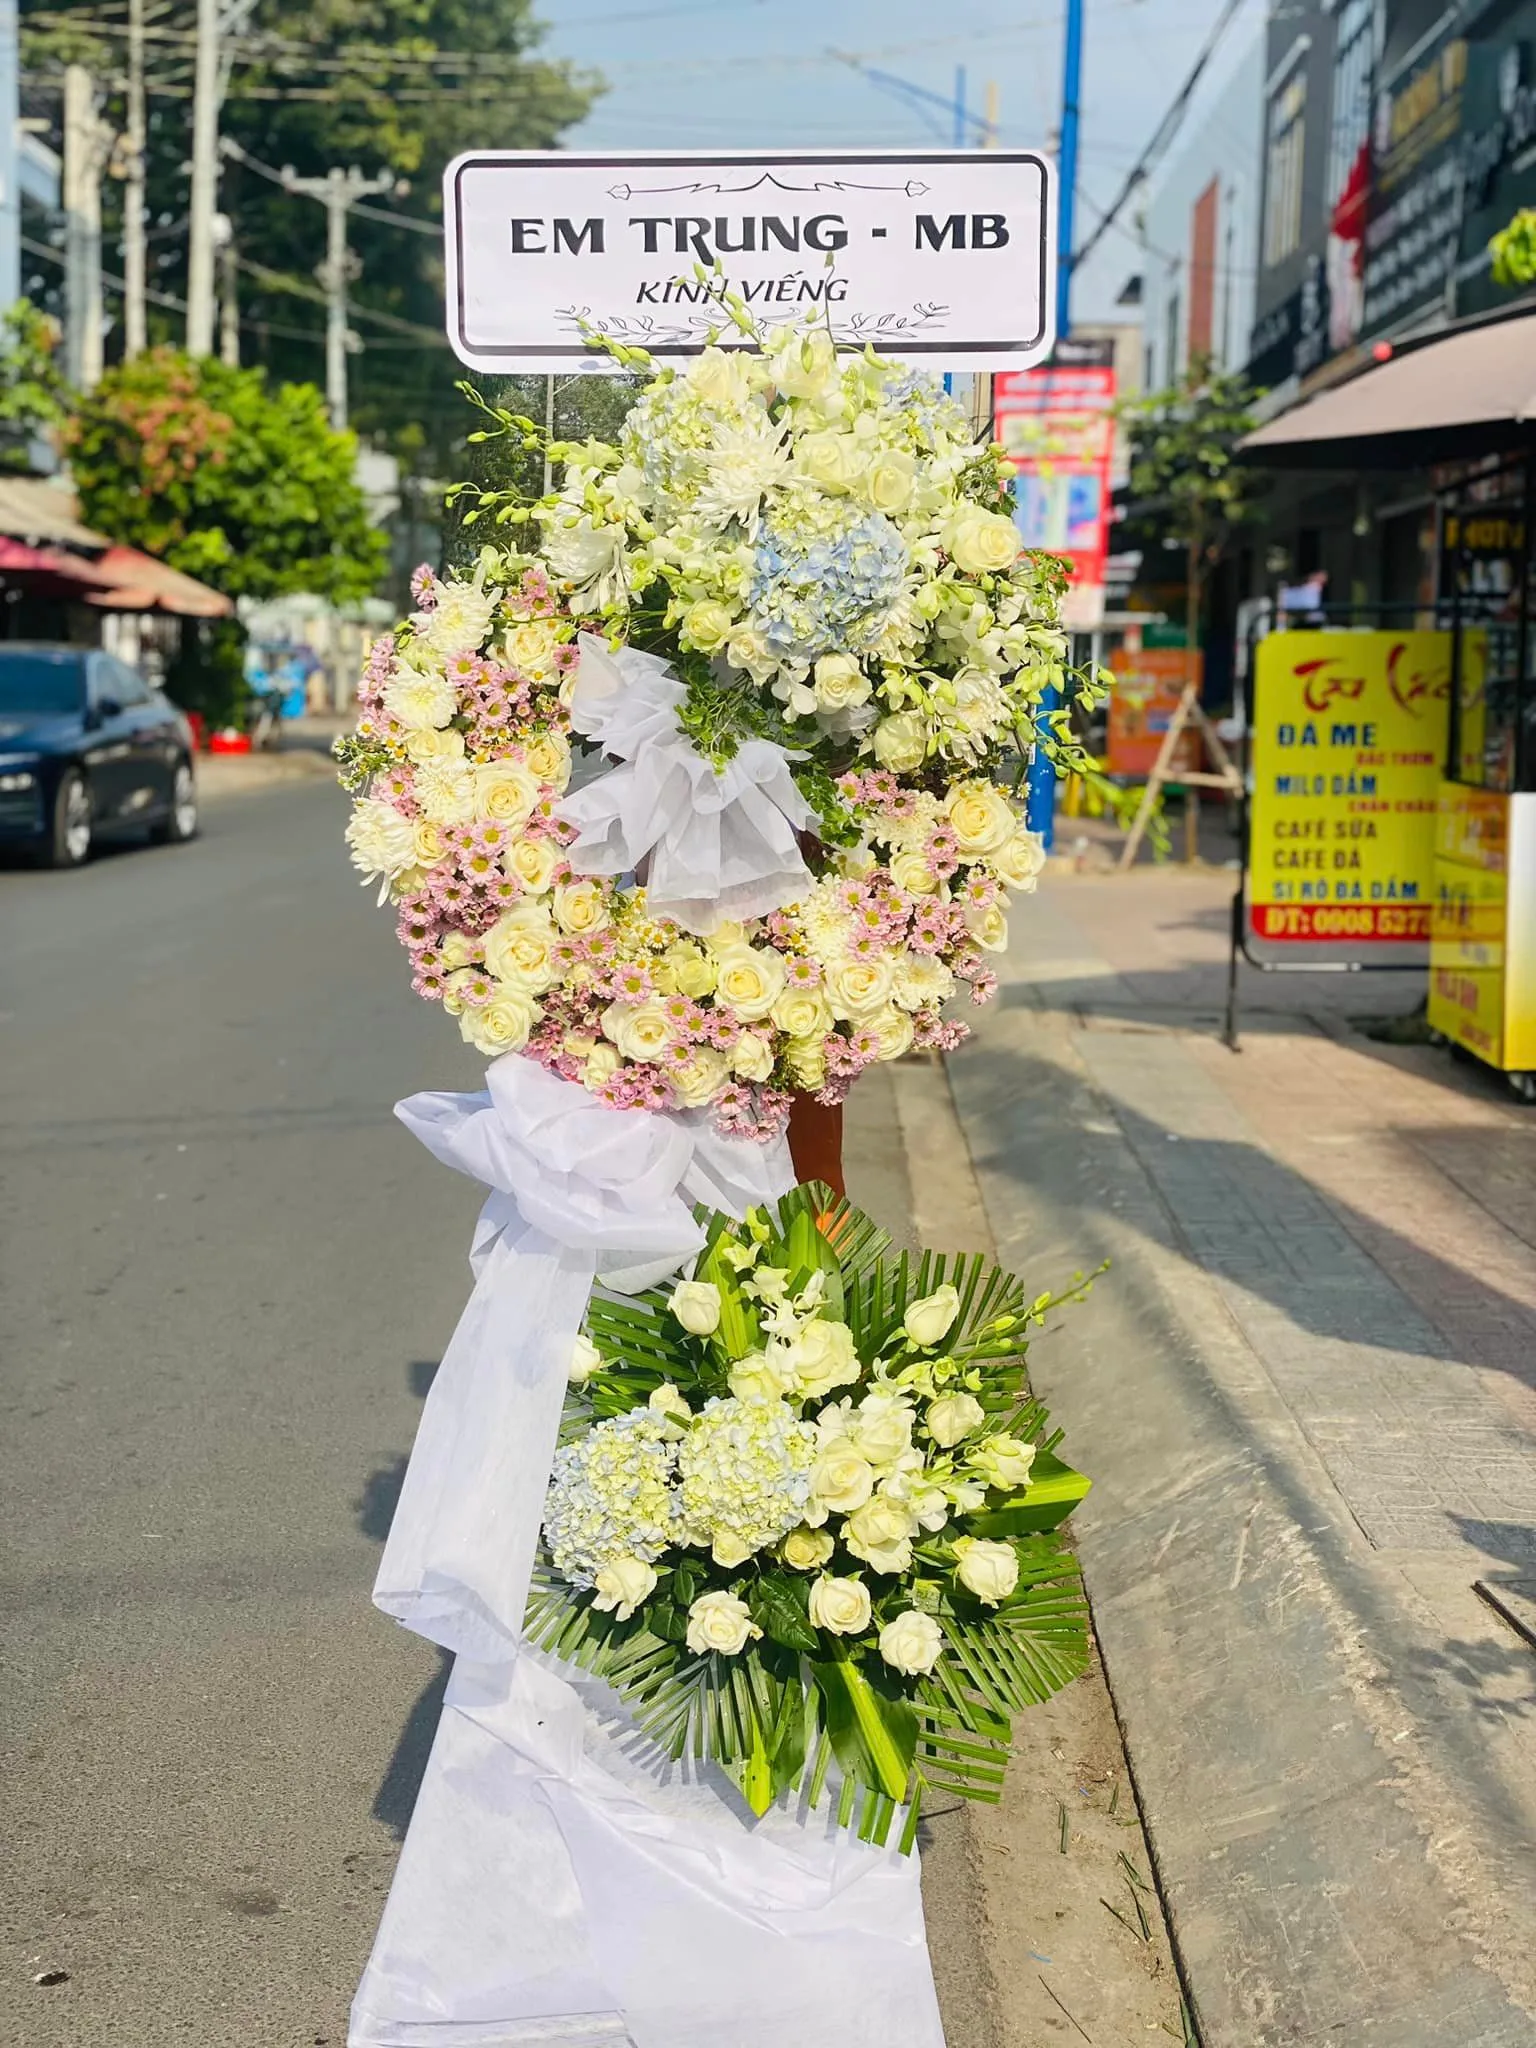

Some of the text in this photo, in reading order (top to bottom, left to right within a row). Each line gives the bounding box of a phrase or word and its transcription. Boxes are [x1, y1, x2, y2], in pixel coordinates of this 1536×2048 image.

[511, 214, 1010, 267] EM TRUNG - MB
[636, 271, 849, 305] KÍNH VIẾNG
